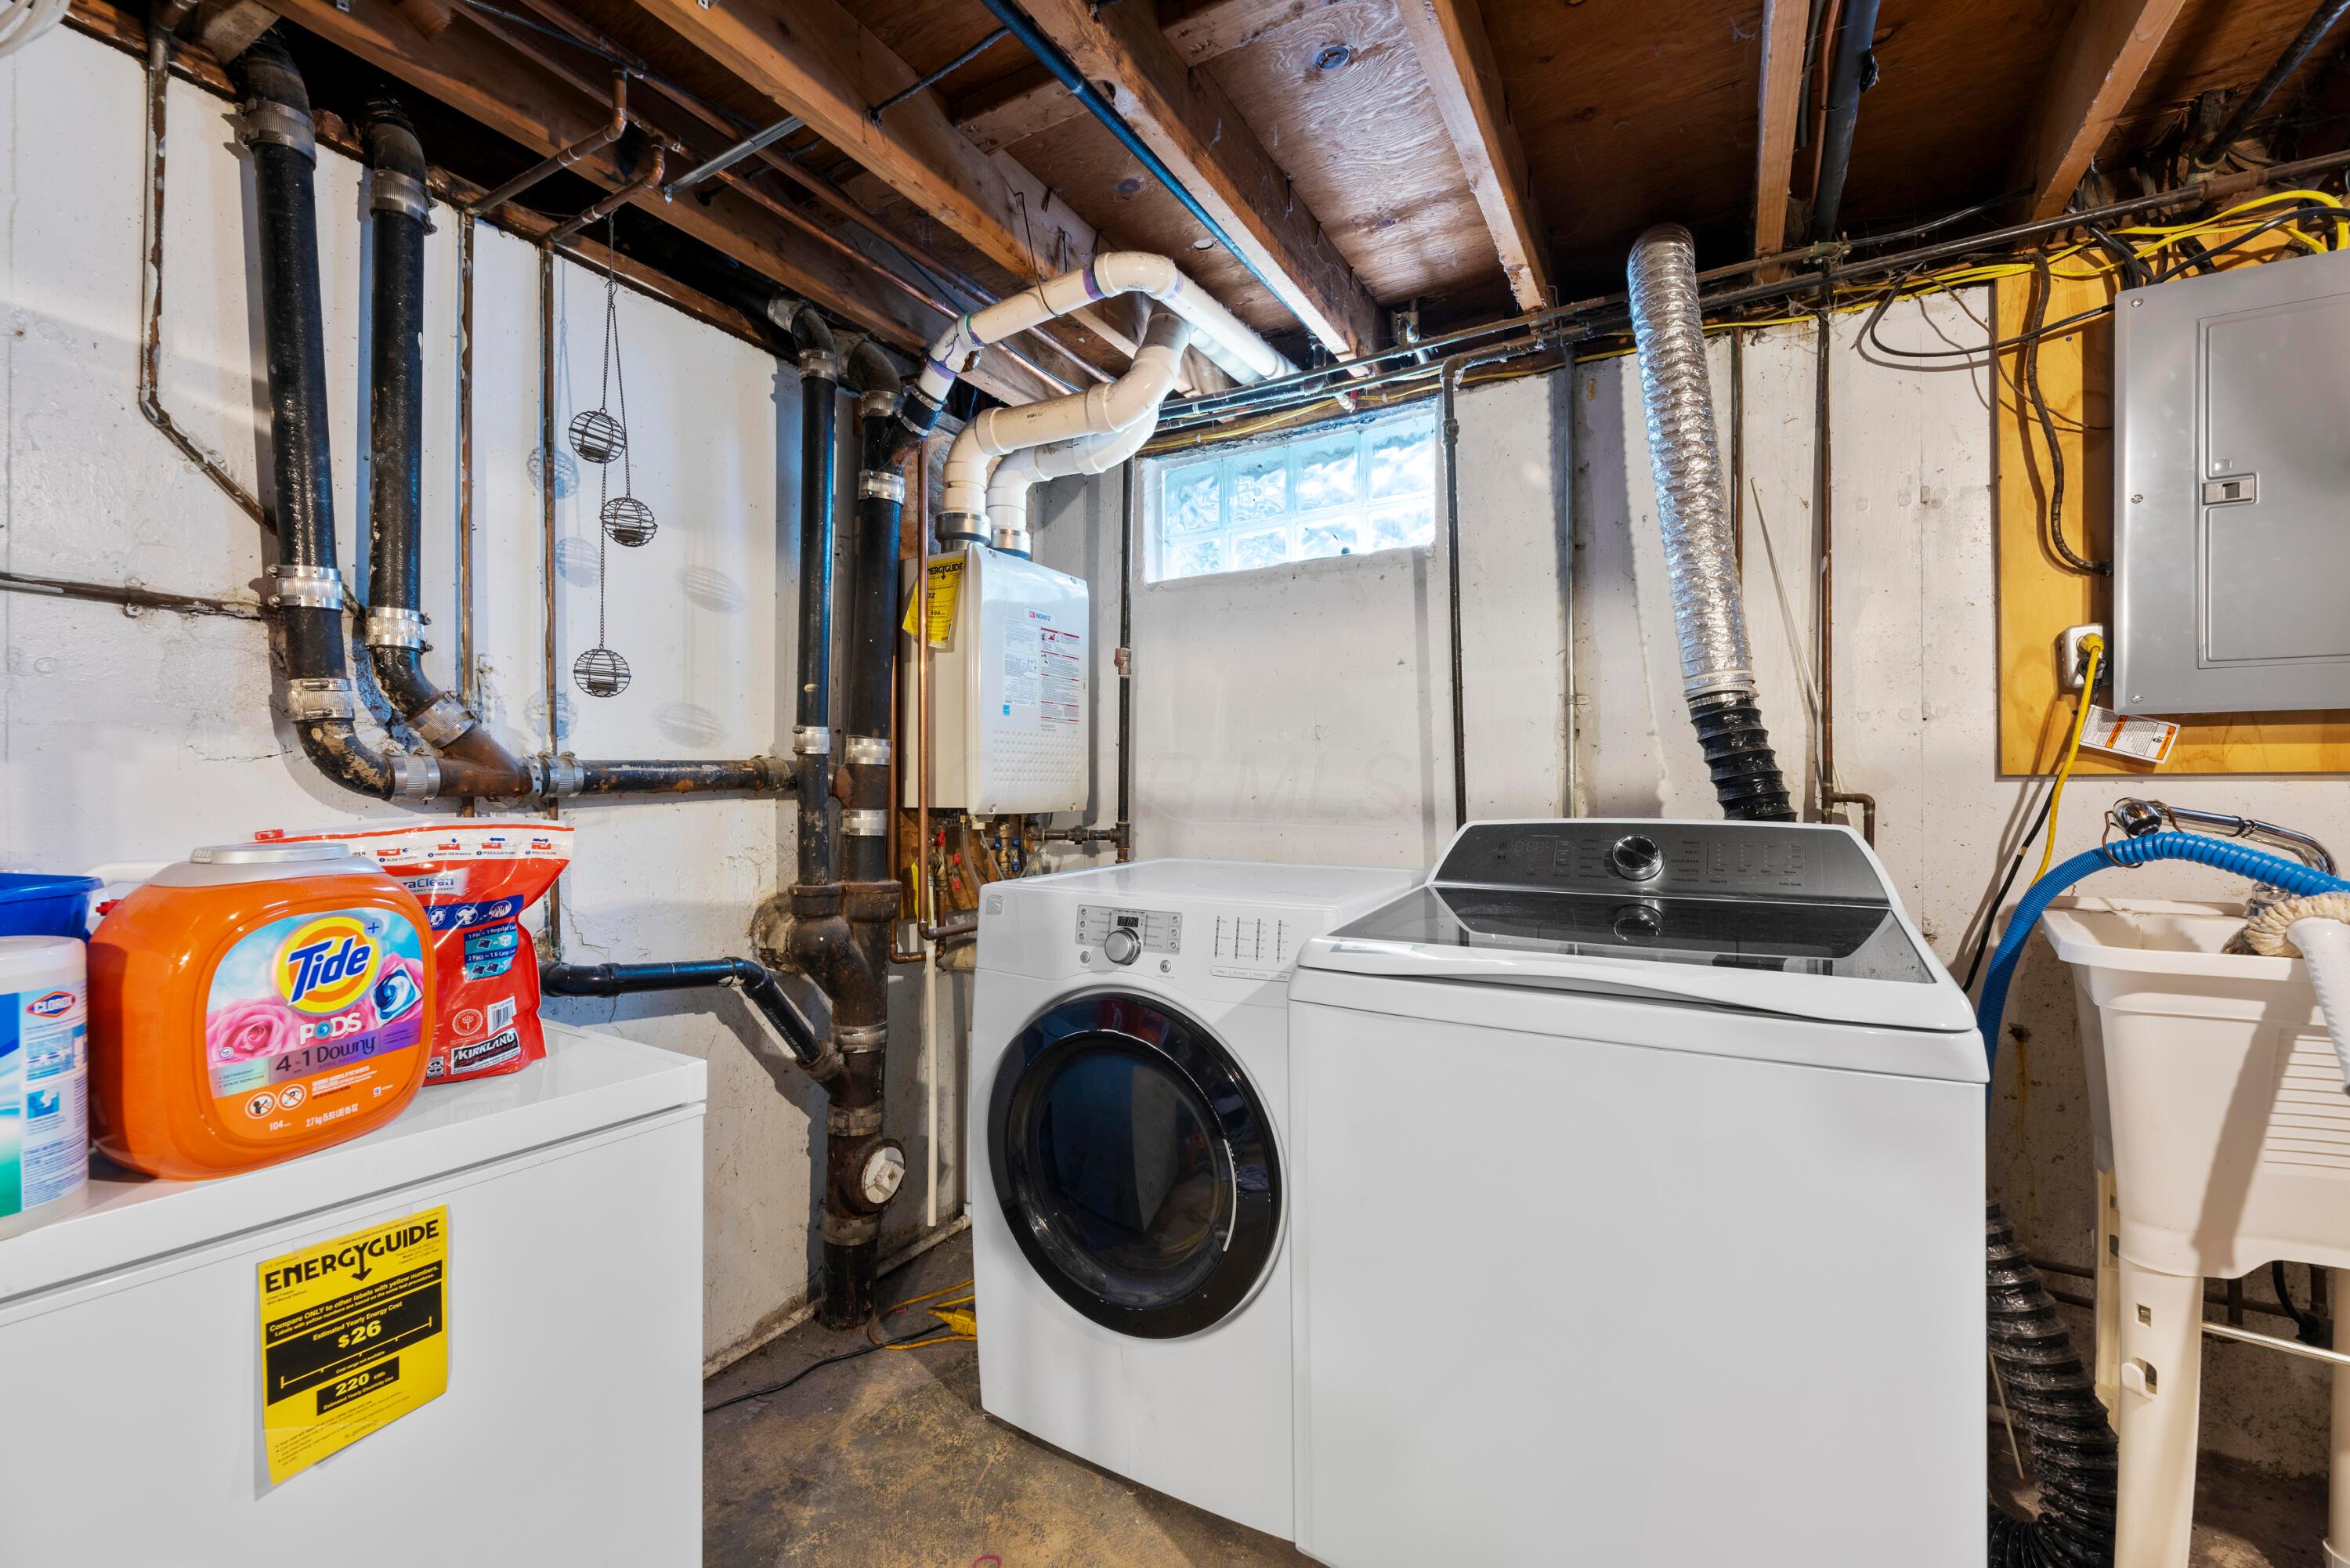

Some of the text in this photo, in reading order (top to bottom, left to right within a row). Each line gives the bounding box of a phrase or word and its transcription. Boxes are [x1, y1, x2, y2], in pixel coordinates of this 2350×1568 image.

[927, 562, 964, 578] NERGYGUIDE
[287, 936, 371, 1004] Tide
[34, 995, 73, 1014] CLOROX
[276, 1036, 376, 1071] 4 1 Downy
[457, 1033, 515, 1060] KIRKLAND
[269, 1119, 284, 1131] 104
[306, 1117, 315, 1127] 2.7
[315, 1115, 323, 1125] kg
[265, 1219, 439, 1294] ENERGYGUIDE
[269, 1266, 439, 1333] Compare ONLY to other labels with yellow numbers.
[274, 1327, 294, 1338] Labels
[294, 1321, 305, 1330] with
[305, 1316, 323, 1328] yellow
[323, 1306, 345, 1319] numbers
[355, 1297, 371, 1308] based
[385, 1286, 399, 1295] same
[399, 1281, 407, 1290] test
[407, 1273, 435, 1287] procedures.
[313, 1301, 403, 1341] Estimated Yearly Energy Cost
[338, 1319, 382, 1349] $26
[346, 1361, 360, 1370] range
[367, 1351, 385, 1360] available
[324, 1396, 348, 1410] Estimated
[347, 1389, 363, 1400] Yearly
[362, 1379, 385, 1393] Electricity
[335, 1373, 370, 1397] 220
